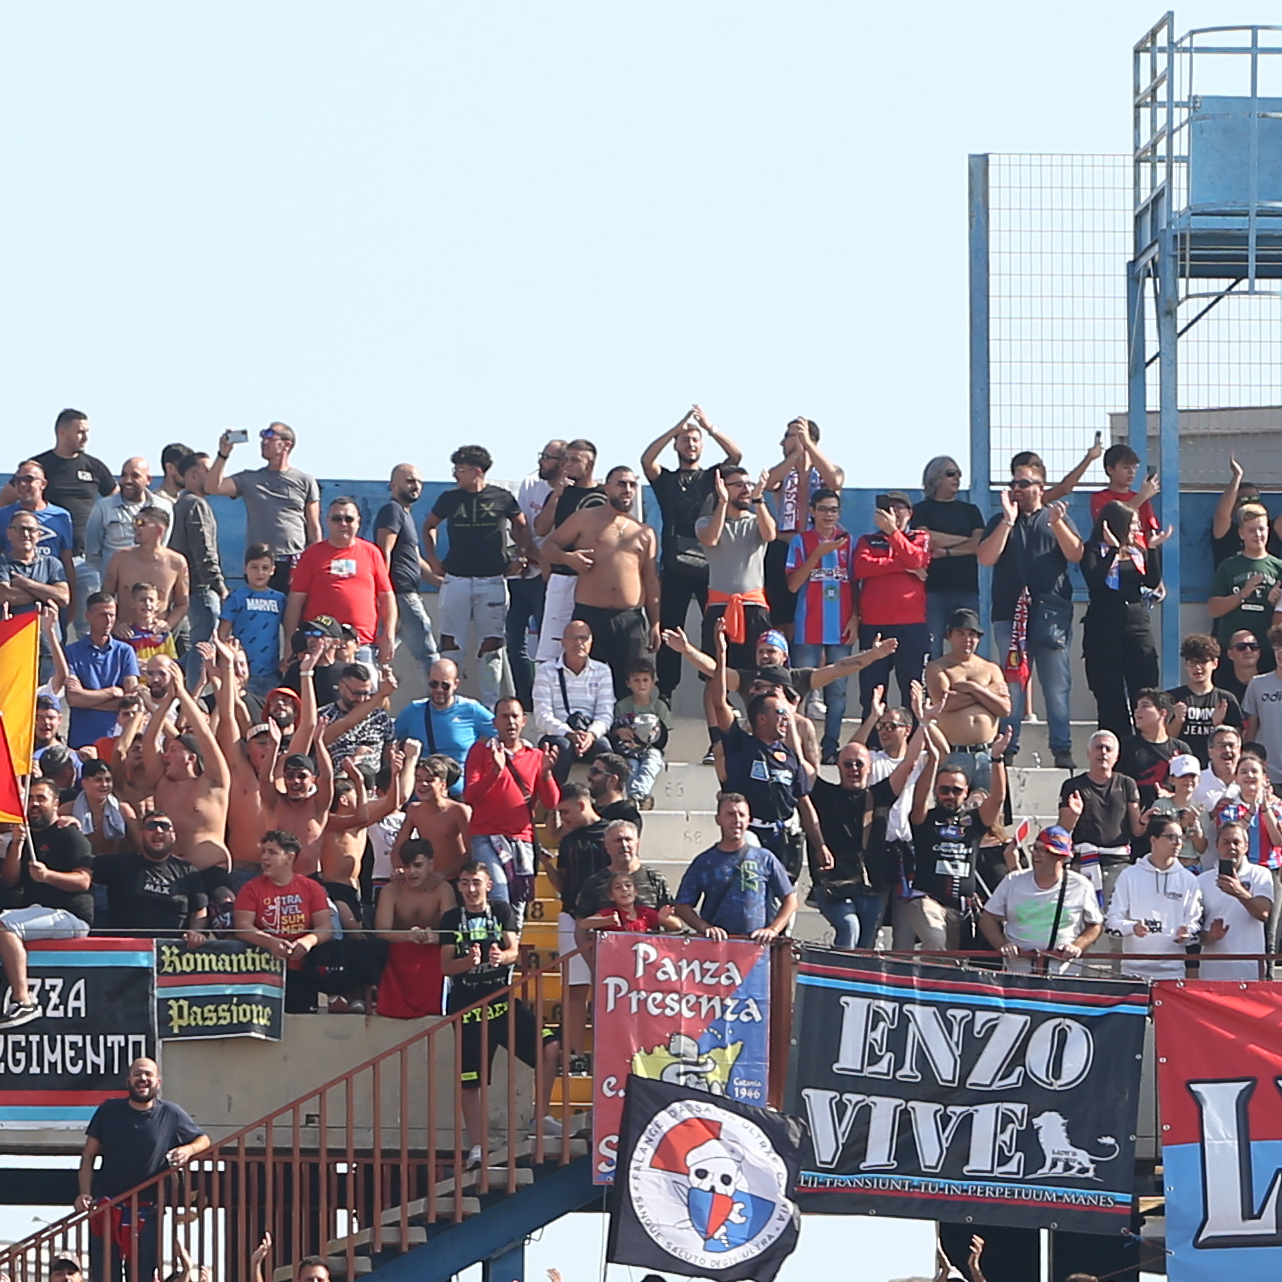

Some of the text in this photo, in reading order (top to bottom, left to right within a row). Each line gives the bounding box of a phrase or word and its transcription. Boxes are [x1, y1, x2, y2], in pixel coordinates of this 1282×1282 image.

[246, 598, 281, 614] MARVEL
[280, 894, 302, 905] TRA
[280, 905, 300, 915] VEL
[280, 914, 305, 924] SUM
[160, 943, 282, 974] Romantica
[633, 942, 742, 989] Panza
[604, 974, 764, 1026] Presenza
[168, 996, 273, 1034] Passione
[833, 995, 1096, 1092] ENZO
[731, 1087, 760, 1099] 1946
[802, 1087, 1031, 1179] VIVE
[918, 1182, 938, 1195] TU
[942, 1183, 962, 1196] IN
[968, 1185, 1058, 1202] PERPETUUM
[1062, 1191, 1115, 1208] MANES
